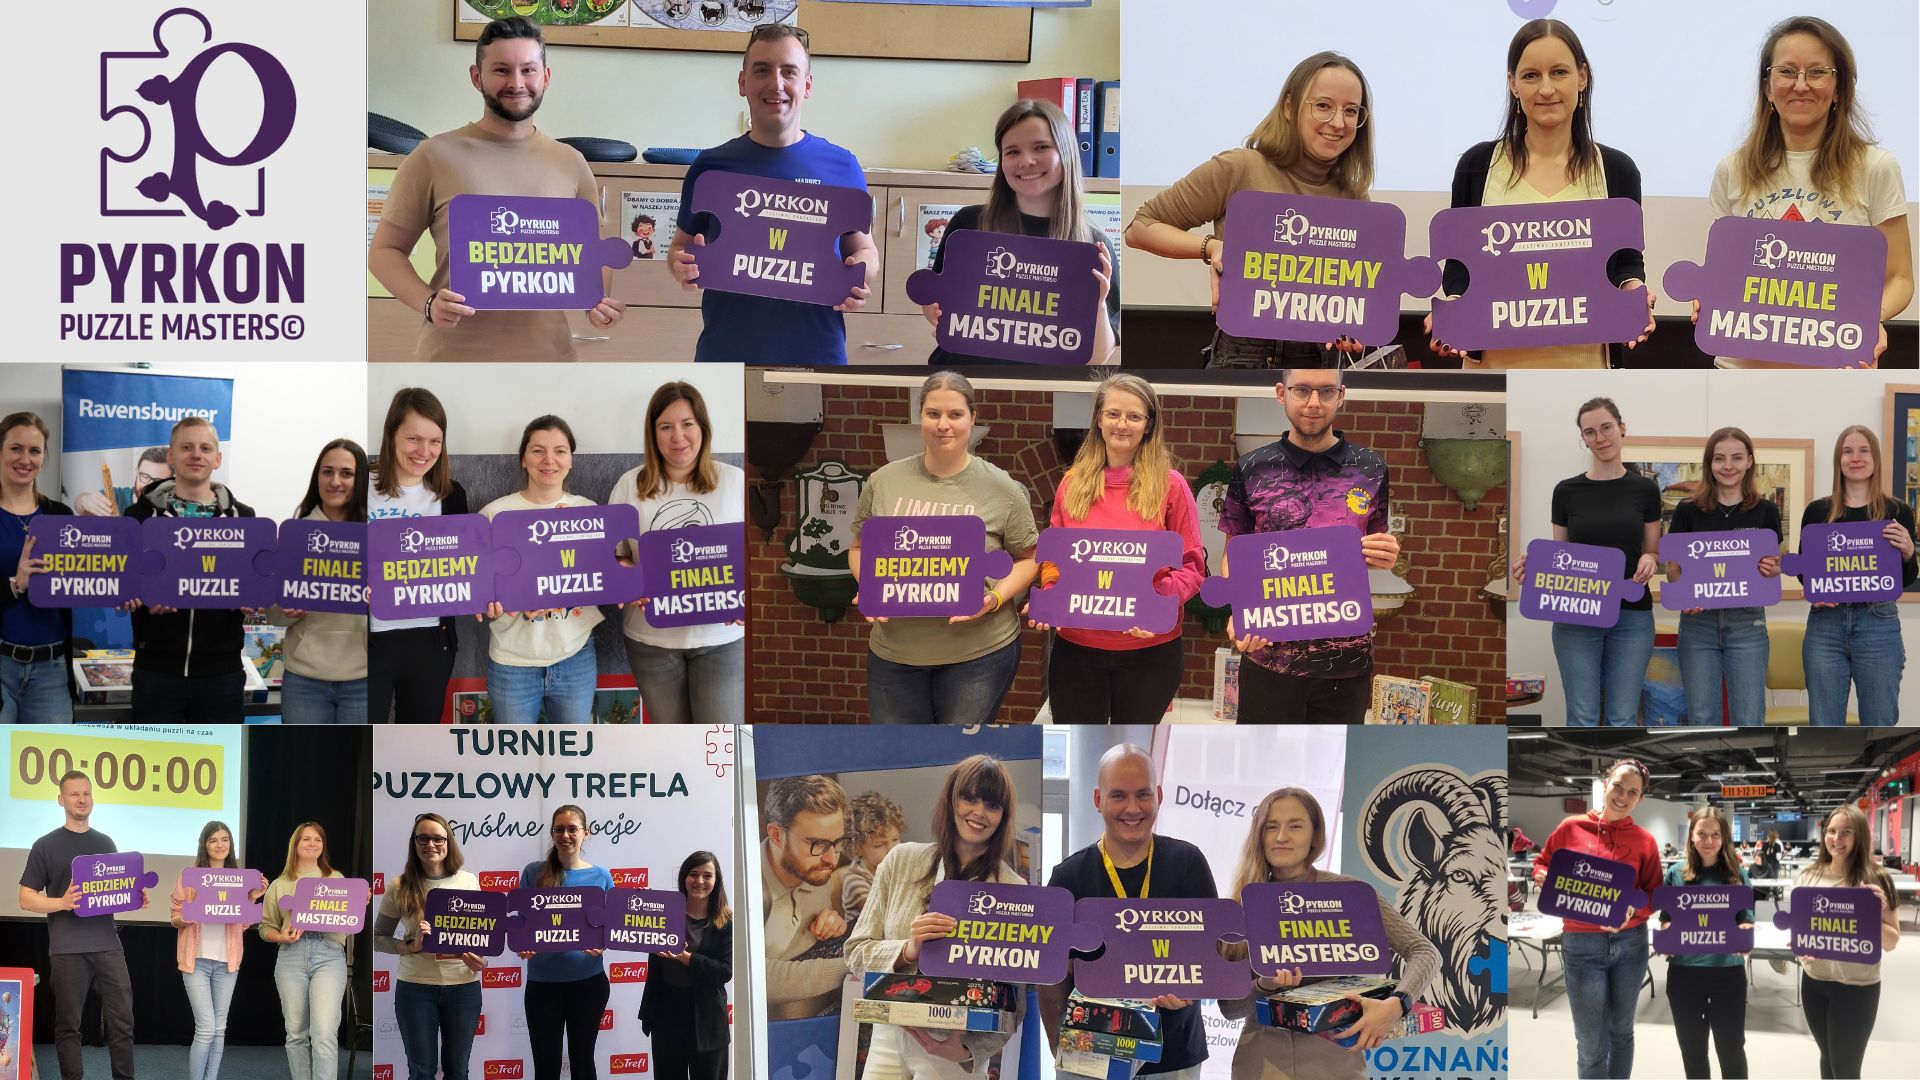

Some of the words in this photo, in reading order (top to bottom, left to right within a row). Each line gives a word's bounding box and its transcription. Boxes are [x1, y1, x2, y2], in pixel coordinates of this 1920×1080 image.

[734, 189, 829, 217] PYRKON
[520, 219, 559, 230] PYRKON
[769, 228, 788, 251] W
[1309, 226, 1357, 242] PYRKON
[1481, 218, 1592, 257] PYRKON
[469, 241, 583, 269] BĘDZIEMY
[1787, 250, 1836, 266] PYRKON
[733, 254, 815, 285] PUZZLE
[1015, 262, 1059, 277] PYRKON
[1243, 251, 1383, 289] BĘDZIEMY
[1786, 262, 1805, 270] PUZZLE
[481, 270, 575, 294] PYRKON
[1526, 262, 1549, 290] W
[977, 284, 1061, 317] FINALE
[1743, 276, 1838, 311] FINALE
[1253, 289, 1366, 325] PYRKON
[1492, 296, 1588, 329] PUZZLE
[948, 313, 1082, 351] MASTERS©
[1709, 309, 1863, 350] MASTERS©
[79, 399, 218, 424] Ravensburger
[81, 534, 112, 544] PYRKON
[173, 527, 245, 550] PYRKON
[527, 517, 604, 545] PYRKON
[918, 535, 952, 545] PYRKON
[329, 540, 360, 550] PYRKON
[425, 535, 458, 546] PYRKON
[1687, 539, 1750, 560] PYRKON
[1847, 538, 1874, 546] PYRKON
[560, 549, 576, 568] W
[694, 544, 728, 556] PYRKON
[1070, 539, 1147, 563] PYRKON
[1290, 550, 1327, 563] PYRKON
[43, 554, 128, 576] BĘDZIEMY
[202, 555, 216, 573] W
[303, 558, 362, 579] FINALE
[383, 555, 479, 585] BĘDZIEMY
[874, 557, 970, 582] BĘDZIEMY
[1572, 559, 1599, 570] PYRKON
[1713, 563, 1726, 578] W
[1826, 555, 1878, 572] FINALE
[537, 572, 604, 596] PUZZLE
[670, 565, 735, 589] FINALE
[1098, 570, 1114, 590] W
[1535, 572, 1612, 596] BĘDZIEMY
[1811, 575, 1895, 594] MASTERS©
[50, 577, 119, 596] PYRKON
[178, 578, 240, 596] PUZZLE
[394, 582, 471, 606] PYRKON
[882, 583, 960, 603] PYRKON
[1262, 573, 1336, 600] FINALE
[1694, 581, 1748, 599] PUZZLE
[1069, 594, 1137, 617] PUZZLE
[1539, 593, 1601, 616] PYRKON
[1243, 600, 1361, 629] MASTERS©
[162, 726, 184, 735] puzzli
[450, 729, 594, 757] TURNIEJ
[565, 772, 689, 799] TREFLA
[1722, 787, 1735, 796] 1-11
[1737, 787, 1750, 796] 1-12
[1752, 786, 1765, 796] 1-13
[1175, 785, 1246, 818] Dołącz
[201, 873, 243, 888] PYRKON
[494, 876, 517, 889] Trefl
[624, 872, 646, 885] Trefl
[1590, 868, 1613, 880] PYRKON
[82, 877, 136, 896] BĘDZIEMY
[1554, 875, 1622, 902] BĘDZIEMY
[88, 892, 131, 909] PYRKON
[218, 890, 227, 902] W
[530, 894, 582, 911] PYRKON
[1306, 900, 1343, 908] PYRKON
[1677, 893, 1730, 911] PYRKON
[204, 904, 241, 916] PUZZLE
[309, 899, 349, 912] FINALE
[996, 902, 1035, 913] PYRKON
[1556, 894, 1611, 918] PYRKON
[1829, 902, 1855, 910] PYRKON
[434, 915, 497, 932] BĘDZIEMY
[551, 913, 562, 926] W
[624, 913, 667, 930] FINALE
[1114, 908, 1204, 933] PYRKON
[1698, 914, 1709, 928] W
[1810, 917, 1857, 934] FINALE
[535, 929, 580, 943] PUZZLE
[1279, 919, 1353, 939] FINALE
[1680, 931, 1726, 945] PUZZLE
[438, 931, 490, 948] PYRKON
[1152, 939, 1170, 958] W
[948, 944, 1040, 969] PYRKON
[1260, 943, 1380, 964] MASTERS©
[496, 971, 519, 984] Trefl
[623, 966, 646, 979] Trefl
[1124, 964, 1204, 984] PUZZLE
[928, 1006, 952, 1018] 1000
[1431, 1011, 1443, 1029] 500
[1116, 1037, 1136, 1049] 1000
[498, 1064, 521, 1075] Trefl
[623, 1057, 646, 1070] Trefl
